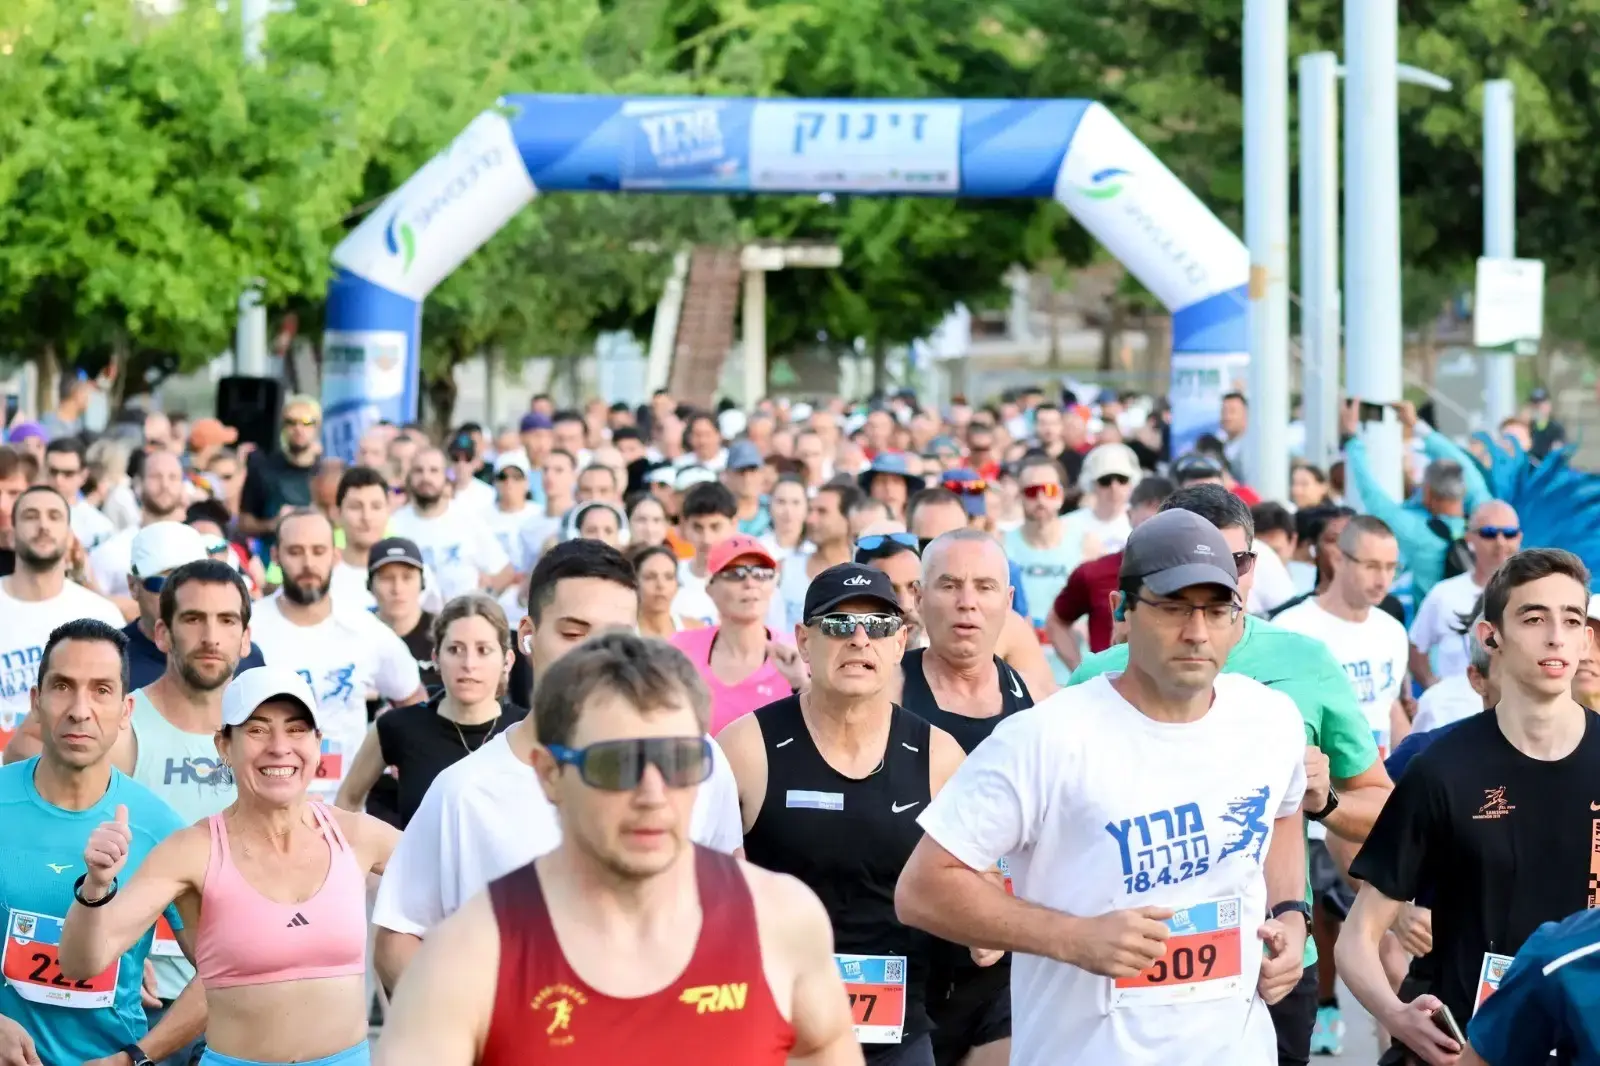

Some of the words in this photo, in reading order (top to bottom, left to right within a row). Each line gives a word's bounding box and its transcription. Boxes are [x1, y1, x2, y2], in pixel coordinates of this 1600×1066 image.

[793, 112, 929, 155] זינוק
[1105, 802, 1204, 876] מרוץ
[1137, 834, 1210, 871] חדרה
[1124, 857, 1209, 894] 18.4.25
